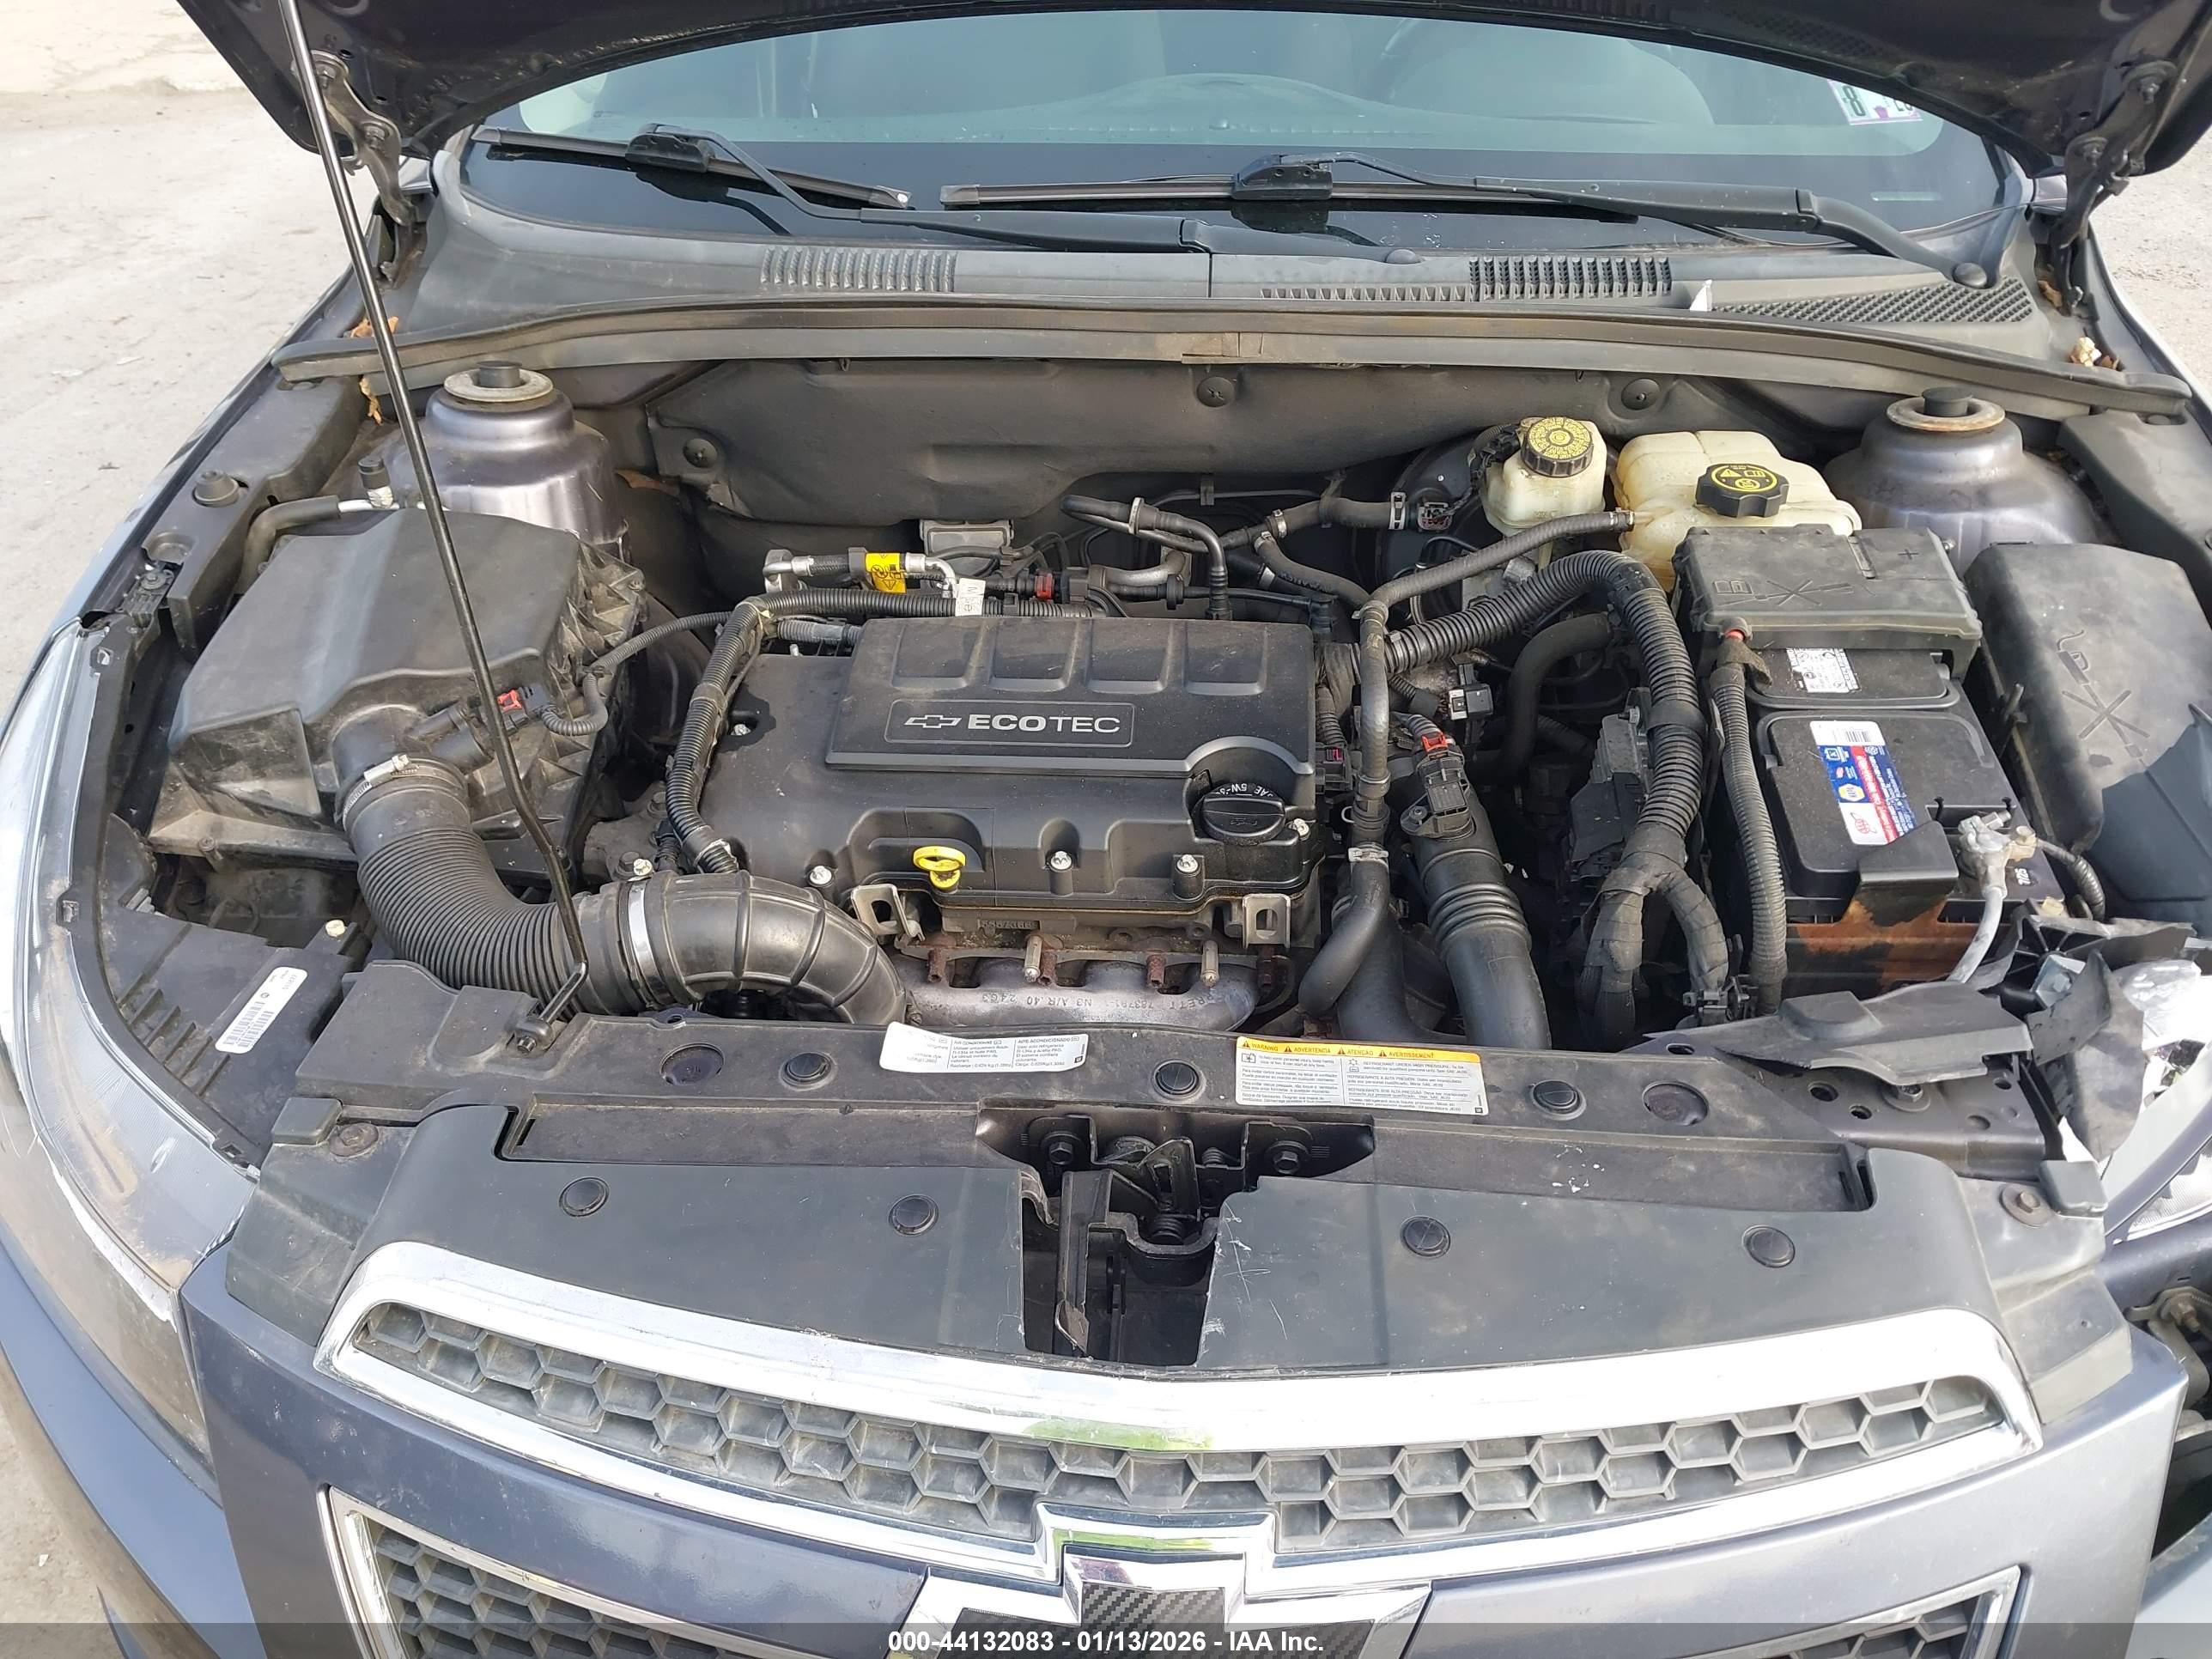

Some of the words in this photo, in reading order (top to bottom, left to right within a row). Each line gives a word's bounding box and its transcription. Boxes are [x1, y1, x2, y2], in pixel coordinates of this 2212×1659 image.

[967, 714, 1121, 734] ECOTEC
[2014, 867, 2032, 886] 7/25
[1251, 1042, 1279, 1052] WARNING
